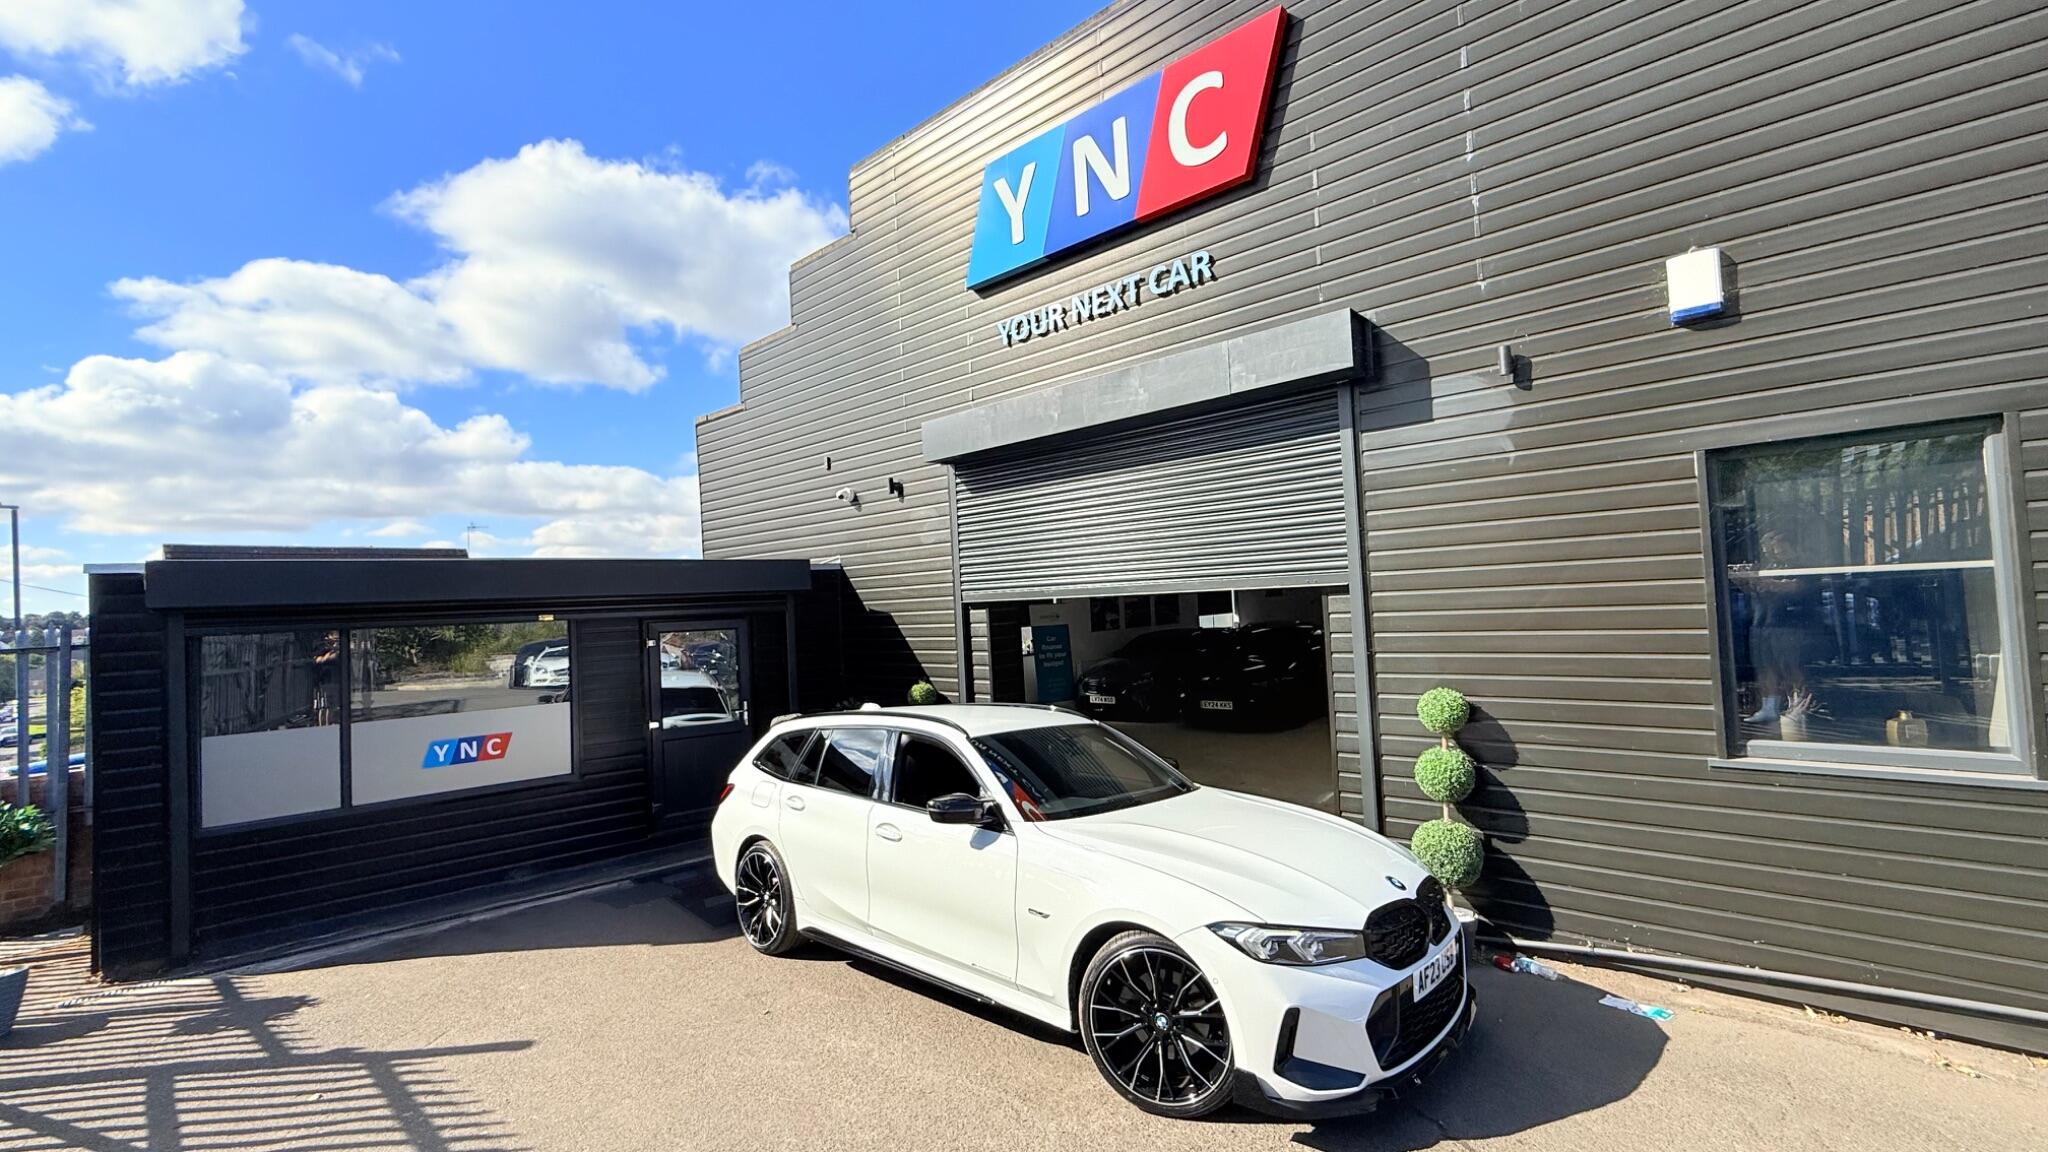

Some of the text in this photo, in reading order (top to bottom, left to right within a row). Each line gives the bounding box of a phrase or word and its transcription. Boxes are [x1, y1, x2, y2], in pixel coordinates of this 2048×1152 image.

[993, 71, 1228, 246] YNC
[997, 250, 1213, 346] YOUR NEXT CAR
[433, 738, 502, 762] YNC
[1418, 957, 1441, 995] AF23
